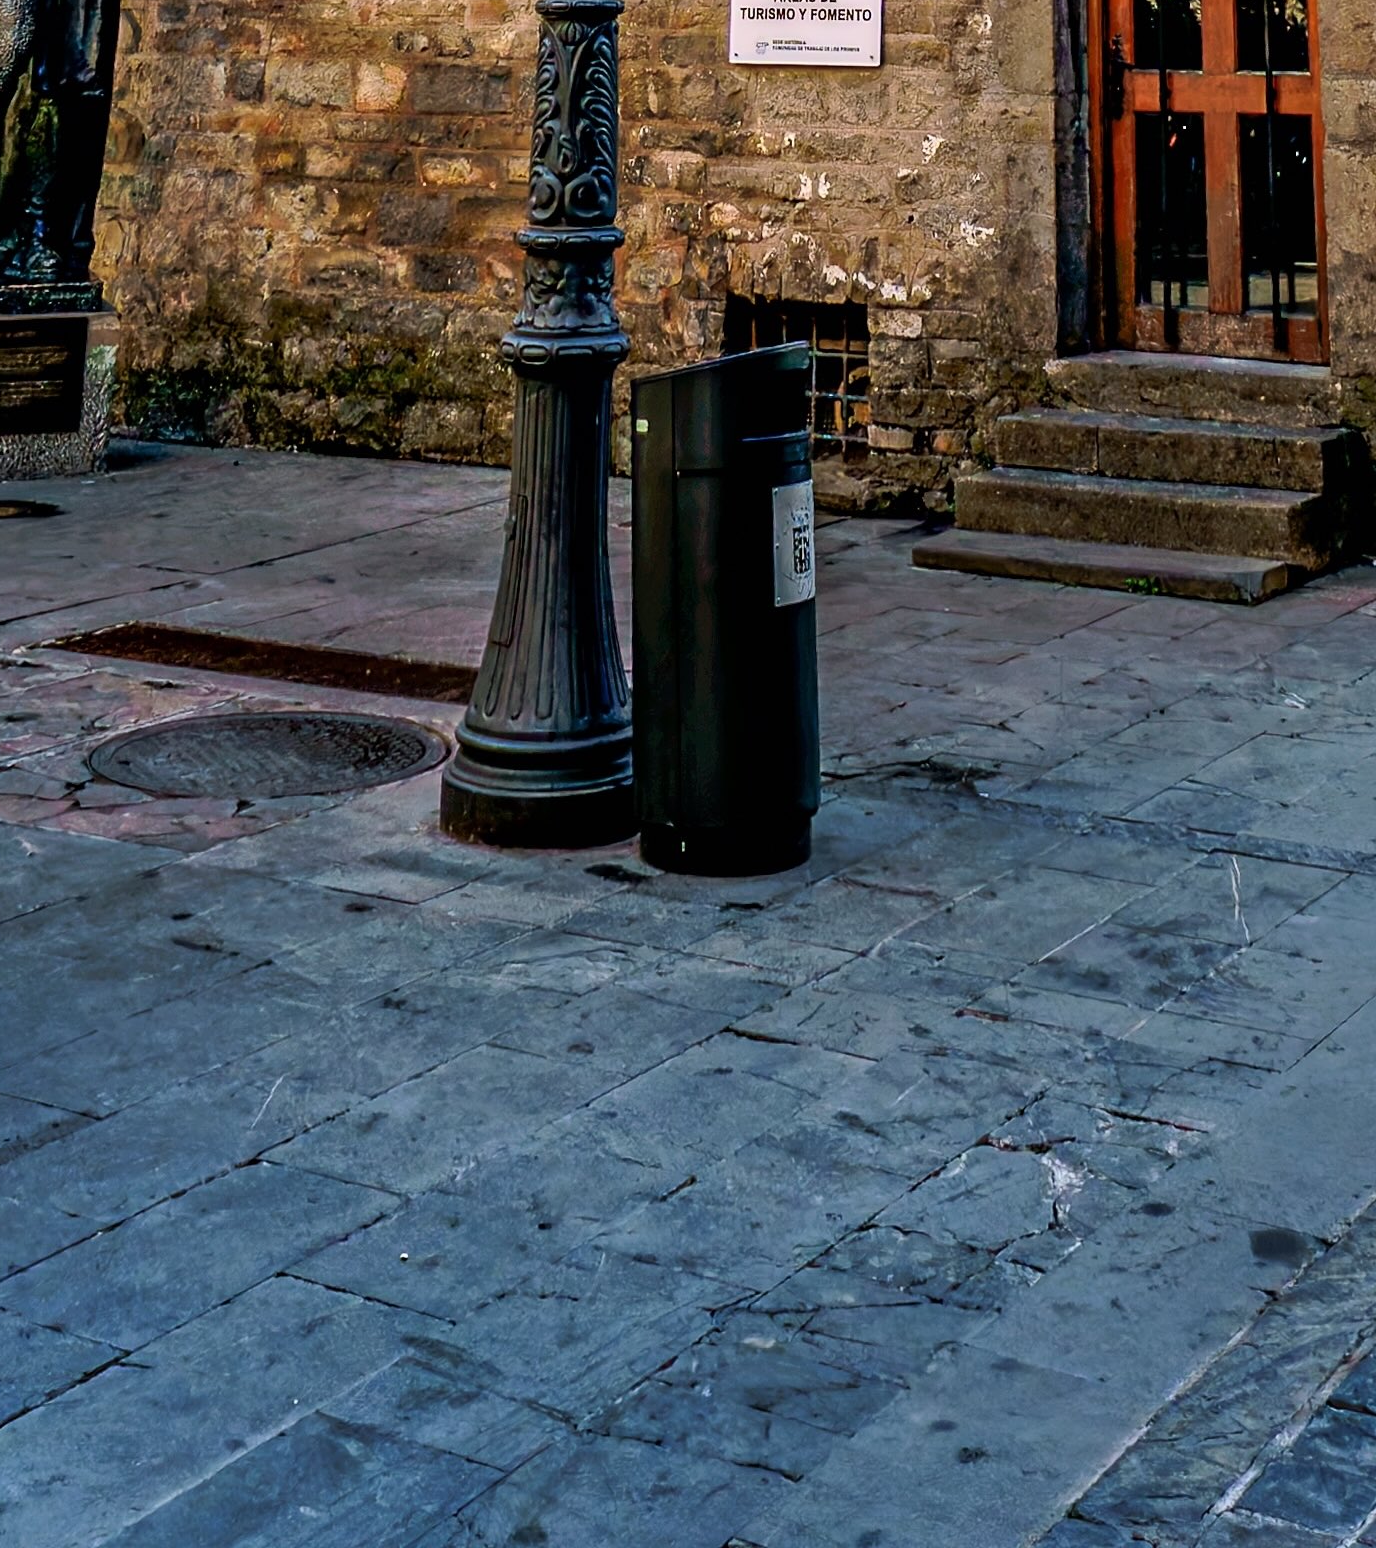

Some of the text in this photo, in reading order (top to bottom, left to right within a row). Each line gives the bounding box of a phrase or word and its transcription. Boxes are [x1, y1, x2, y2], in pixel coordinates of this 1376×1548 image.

[740, 7, 872, 21] TURISMO Y FOMENTO
